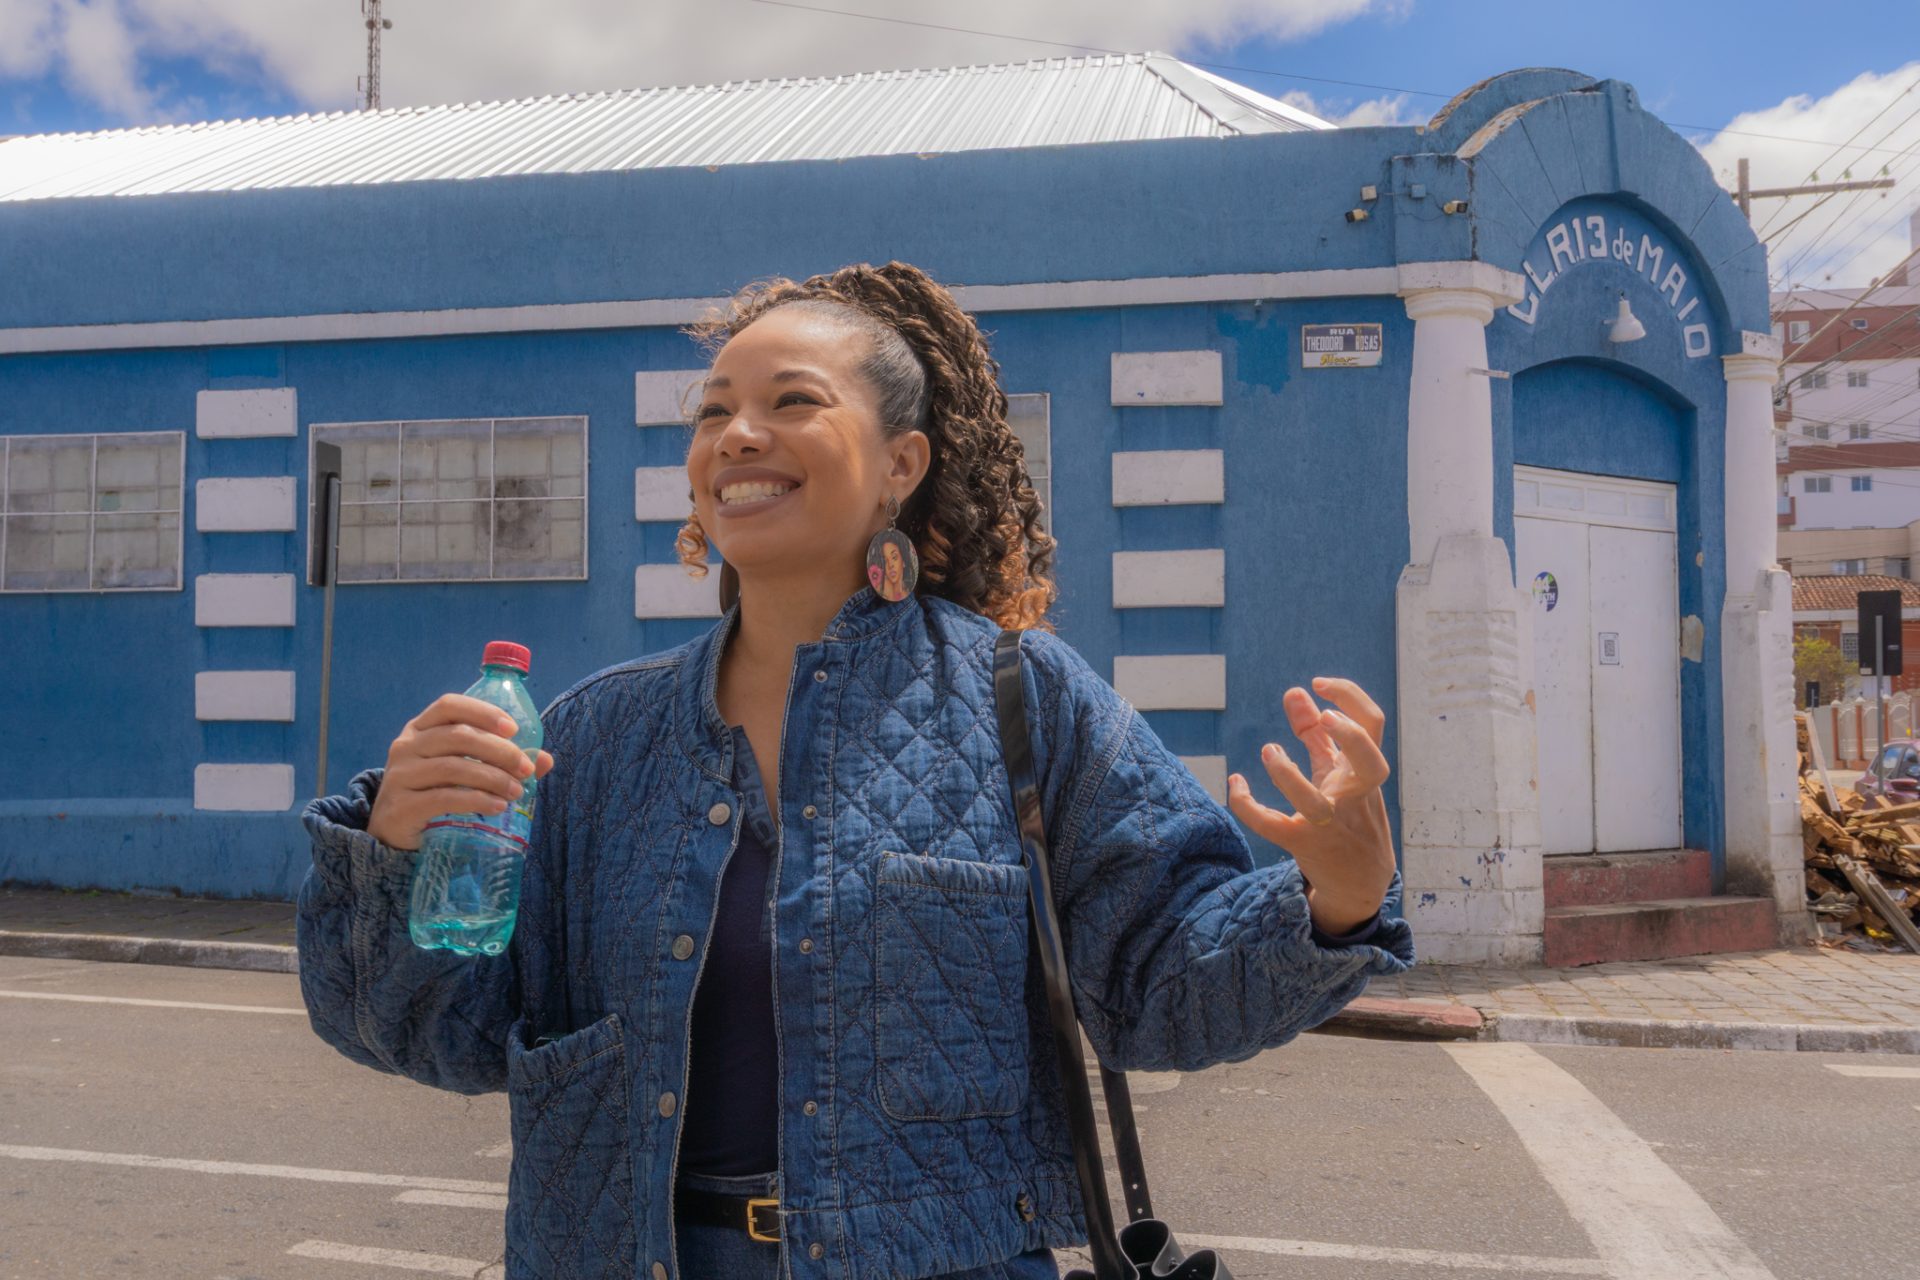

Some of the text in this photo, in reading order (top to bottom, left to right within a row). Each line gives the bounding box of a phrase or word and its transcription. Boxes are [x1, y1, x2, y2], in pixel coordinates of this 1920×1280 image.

[1612, 227, 1634, 265] de
[1637, 234, 1711, 358] MAIO
[1306, 335, 1378, 351] THEODORO ROSAS
